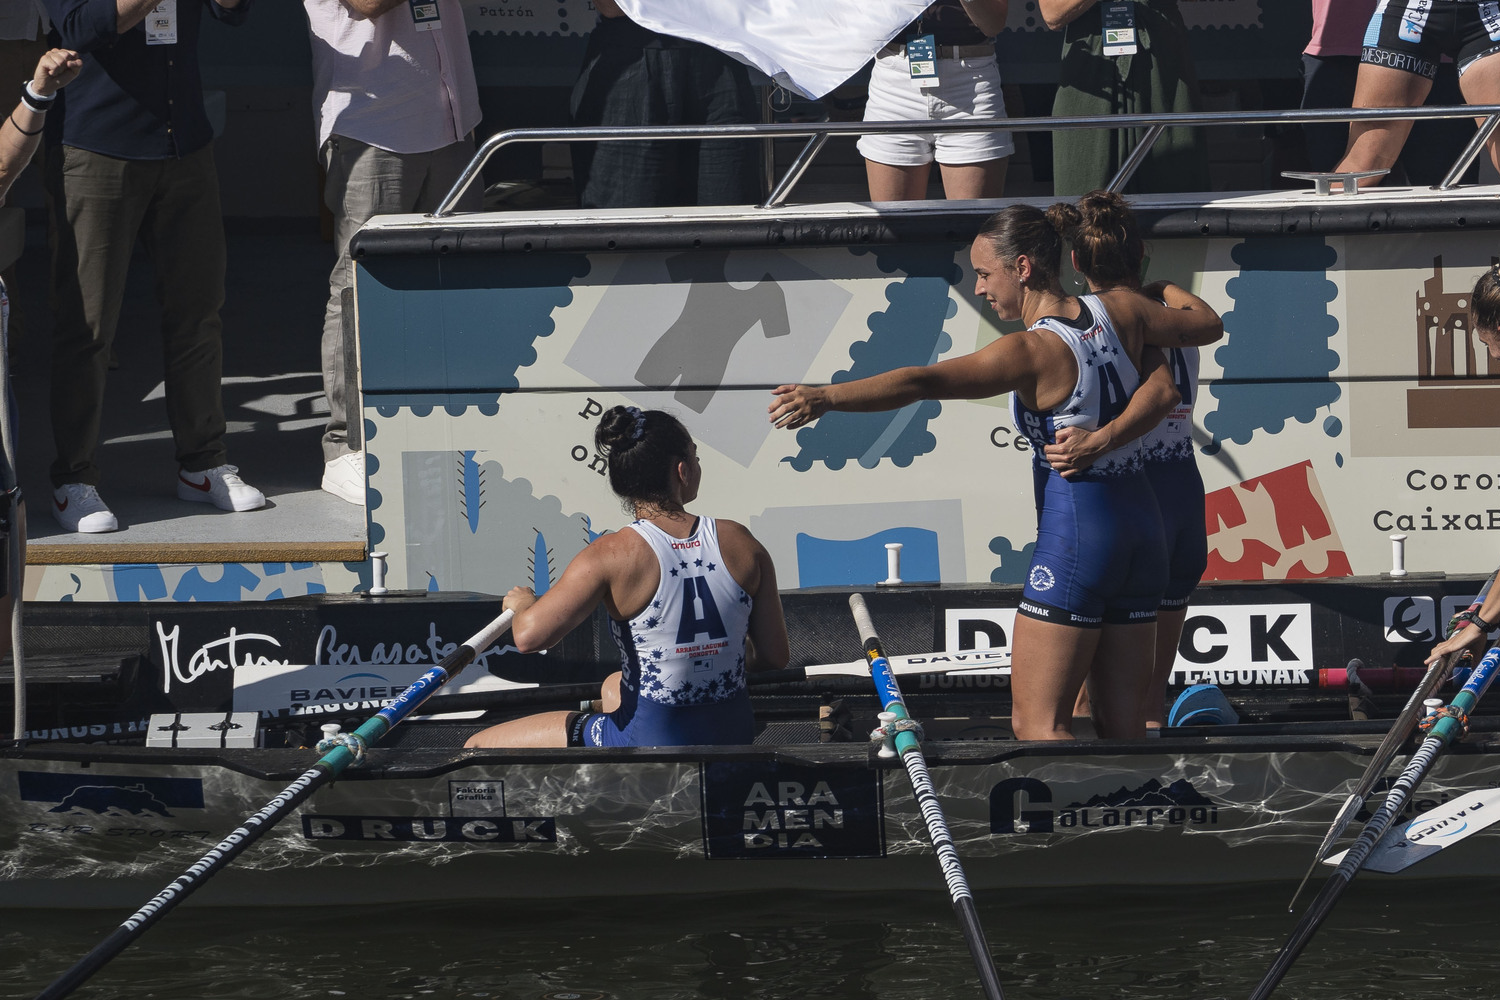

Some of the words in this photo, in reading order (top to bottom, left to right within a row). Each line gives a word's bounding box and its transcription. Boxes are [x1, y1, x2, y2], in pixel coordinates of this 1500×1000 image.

[480, 6, 534, 17] Patrón
[671, 540, 701, 550] amura
[743, 780, 840, 806] ARA
[309, 817, 550, 841] DRUCK
[744, 808, 845, 830] MEN
[28, 822, 96, 835] BAR
[104, 826, 211, 841] SPORT
